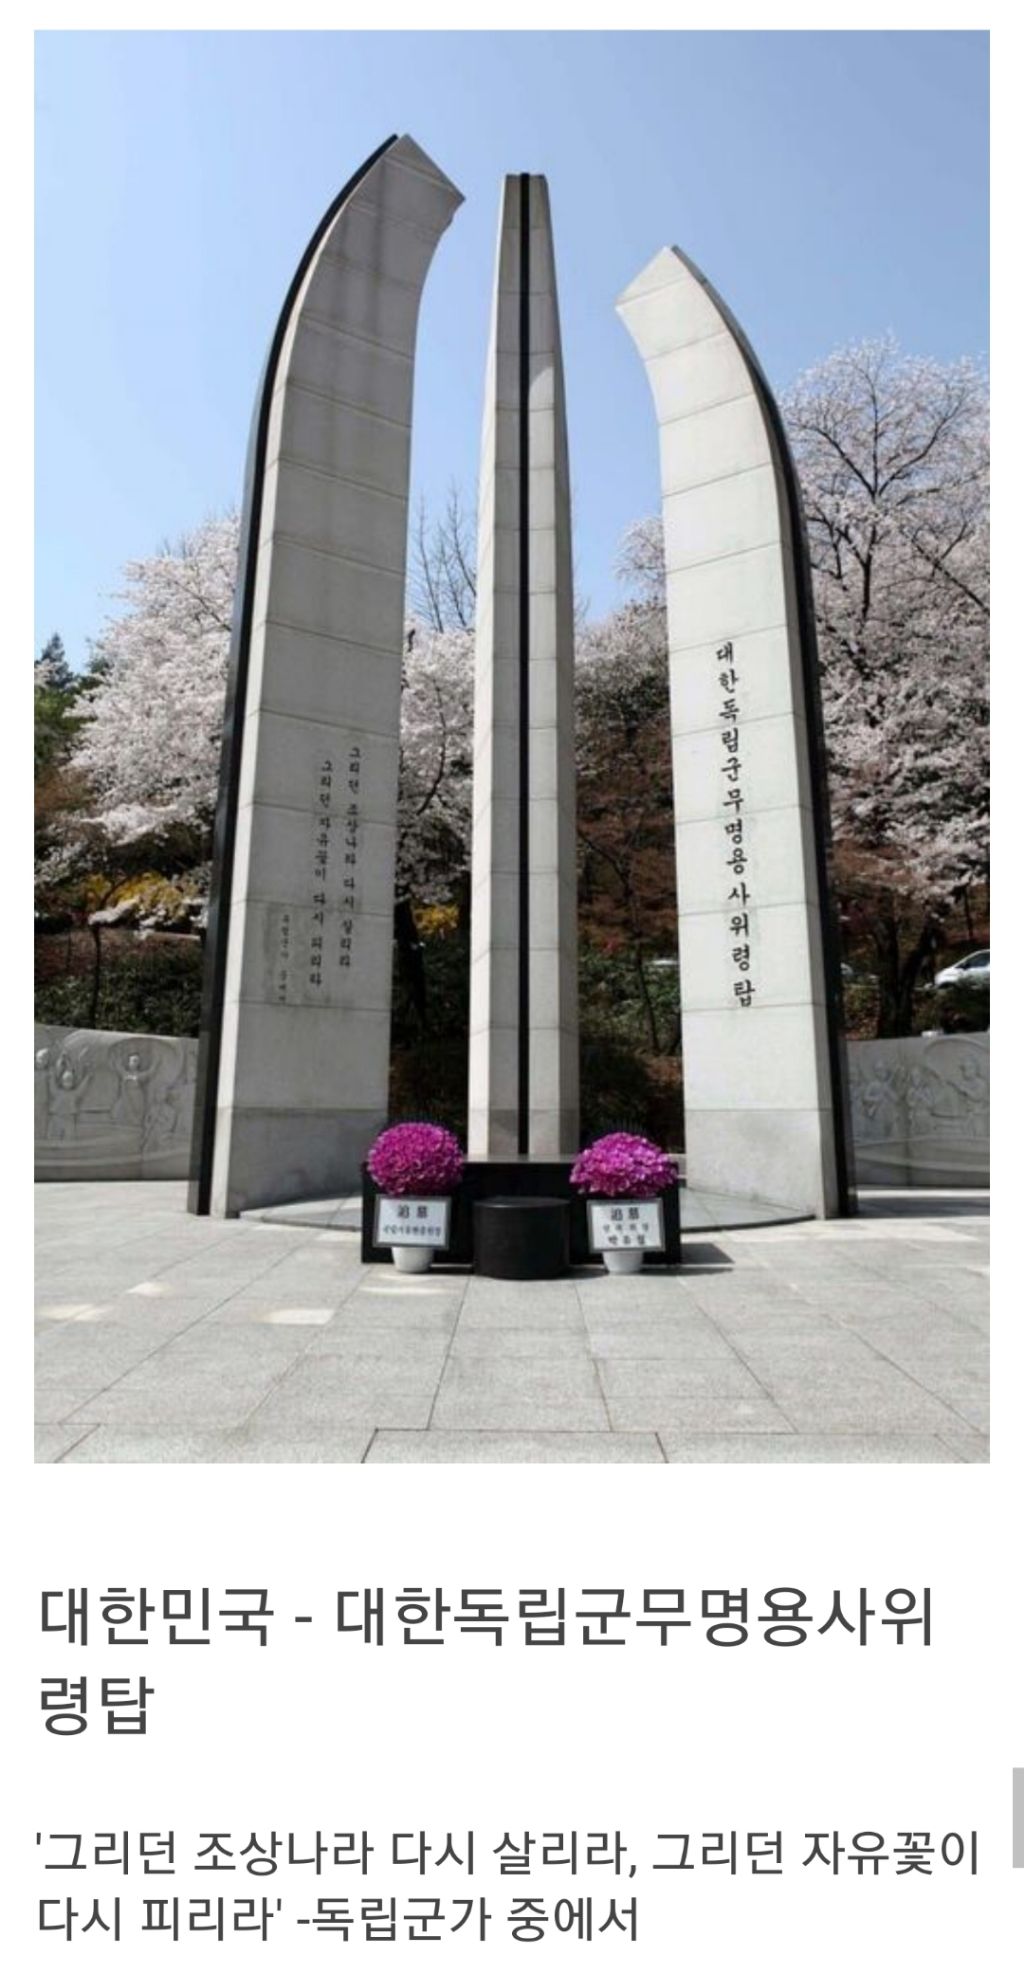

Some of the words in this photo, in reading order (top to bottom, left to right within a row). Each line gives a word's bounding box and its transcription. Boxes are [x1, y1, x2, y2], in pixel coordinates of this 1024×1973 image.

[319, 760, 333, 808] 그리던
[348, 746, 361, 793] 그리던
[715, 641, 756, 1009] 대한독립군무명용사위령탑
[312, 892, 326, 925] 다시
[343, 877, 355, 909] 다시
